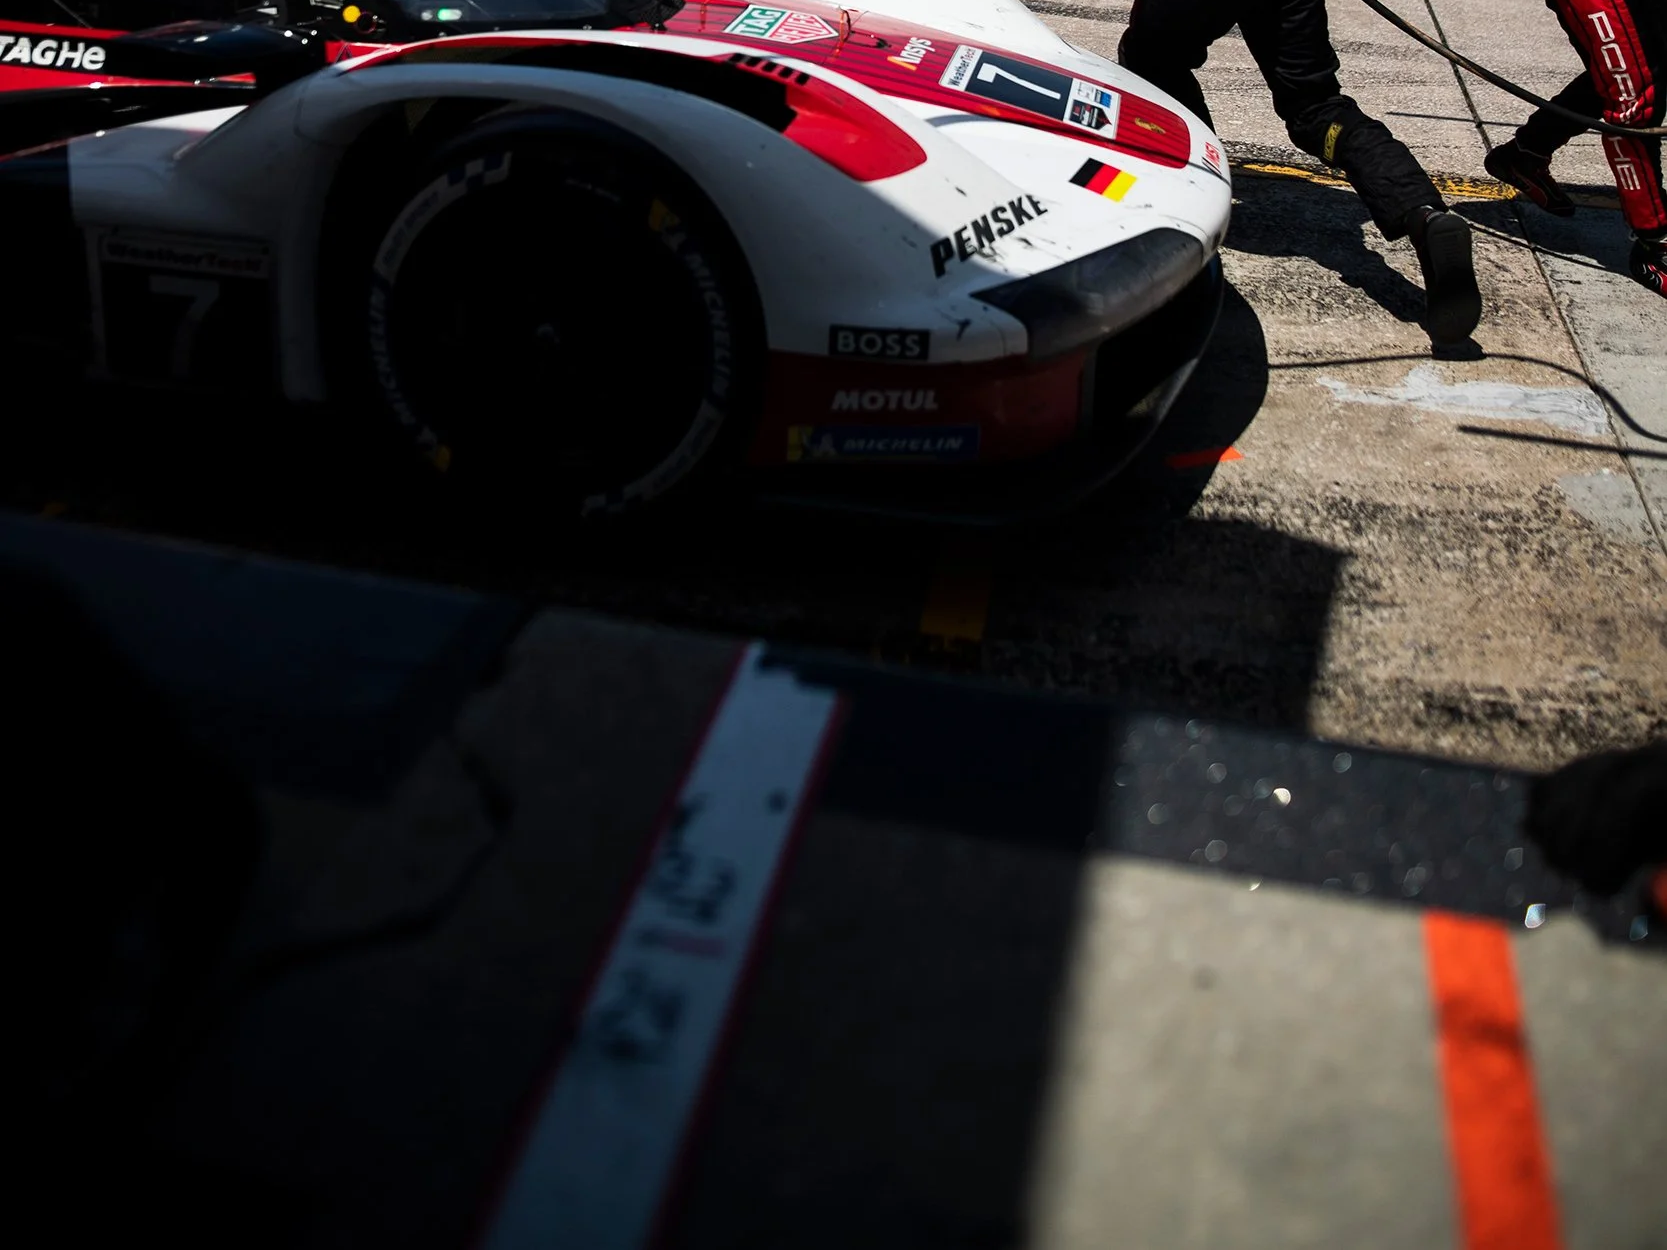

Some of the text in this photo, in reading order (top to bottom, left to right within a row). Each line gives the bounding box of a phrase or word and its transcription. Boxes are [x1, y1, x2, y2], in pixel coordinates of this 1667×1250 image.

[732, 10, 783, 35] TAG
[775, 11, 824, 42] HEUER
[887, 37, 936, 71] Ansys
[948, 47, 977, 88] WeatherTech
[976, 62, 1062, 100] 7
[1588, 11, 1641, 191] PORSHE
[930, 194, 1048, 279] PENSKE
[147, 273, 221, 380] 7
[835, 329, 923, 359] BOSS
[831, 387, 940, 413] MOTUL
[842, 434, 965, 453] MICHELIN
